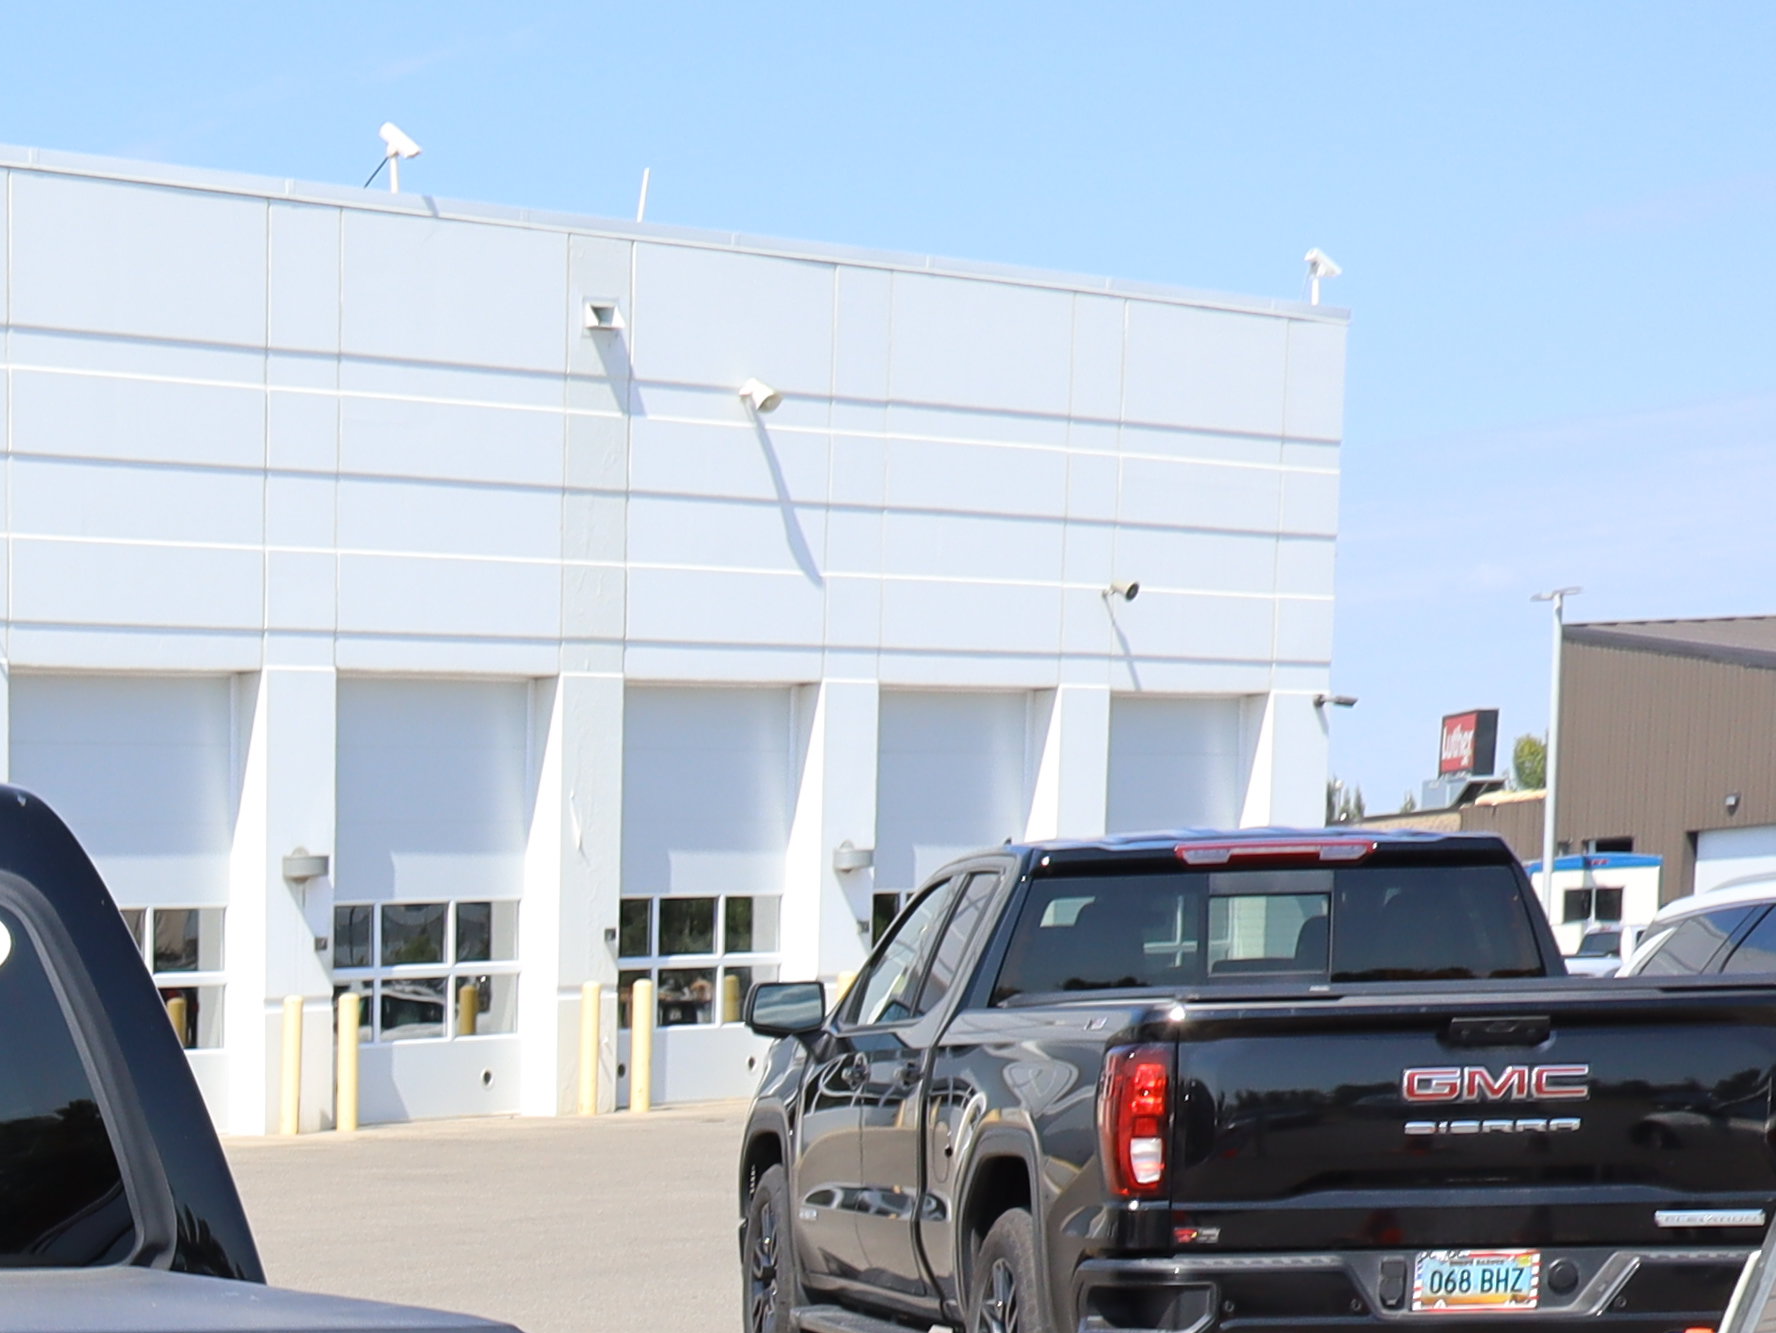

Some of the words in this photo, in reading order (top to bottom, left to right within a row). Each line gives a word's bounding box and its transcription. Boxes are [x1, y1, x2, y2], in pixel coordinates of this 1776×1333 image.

[1403, 1064, 1589, 1101] GMC
[1404, 1118, 1581, 1135] SIERRA
[1429, 1268, 1472, 1294] 068
[1480, 1266, 1525, 1293] BHZ
